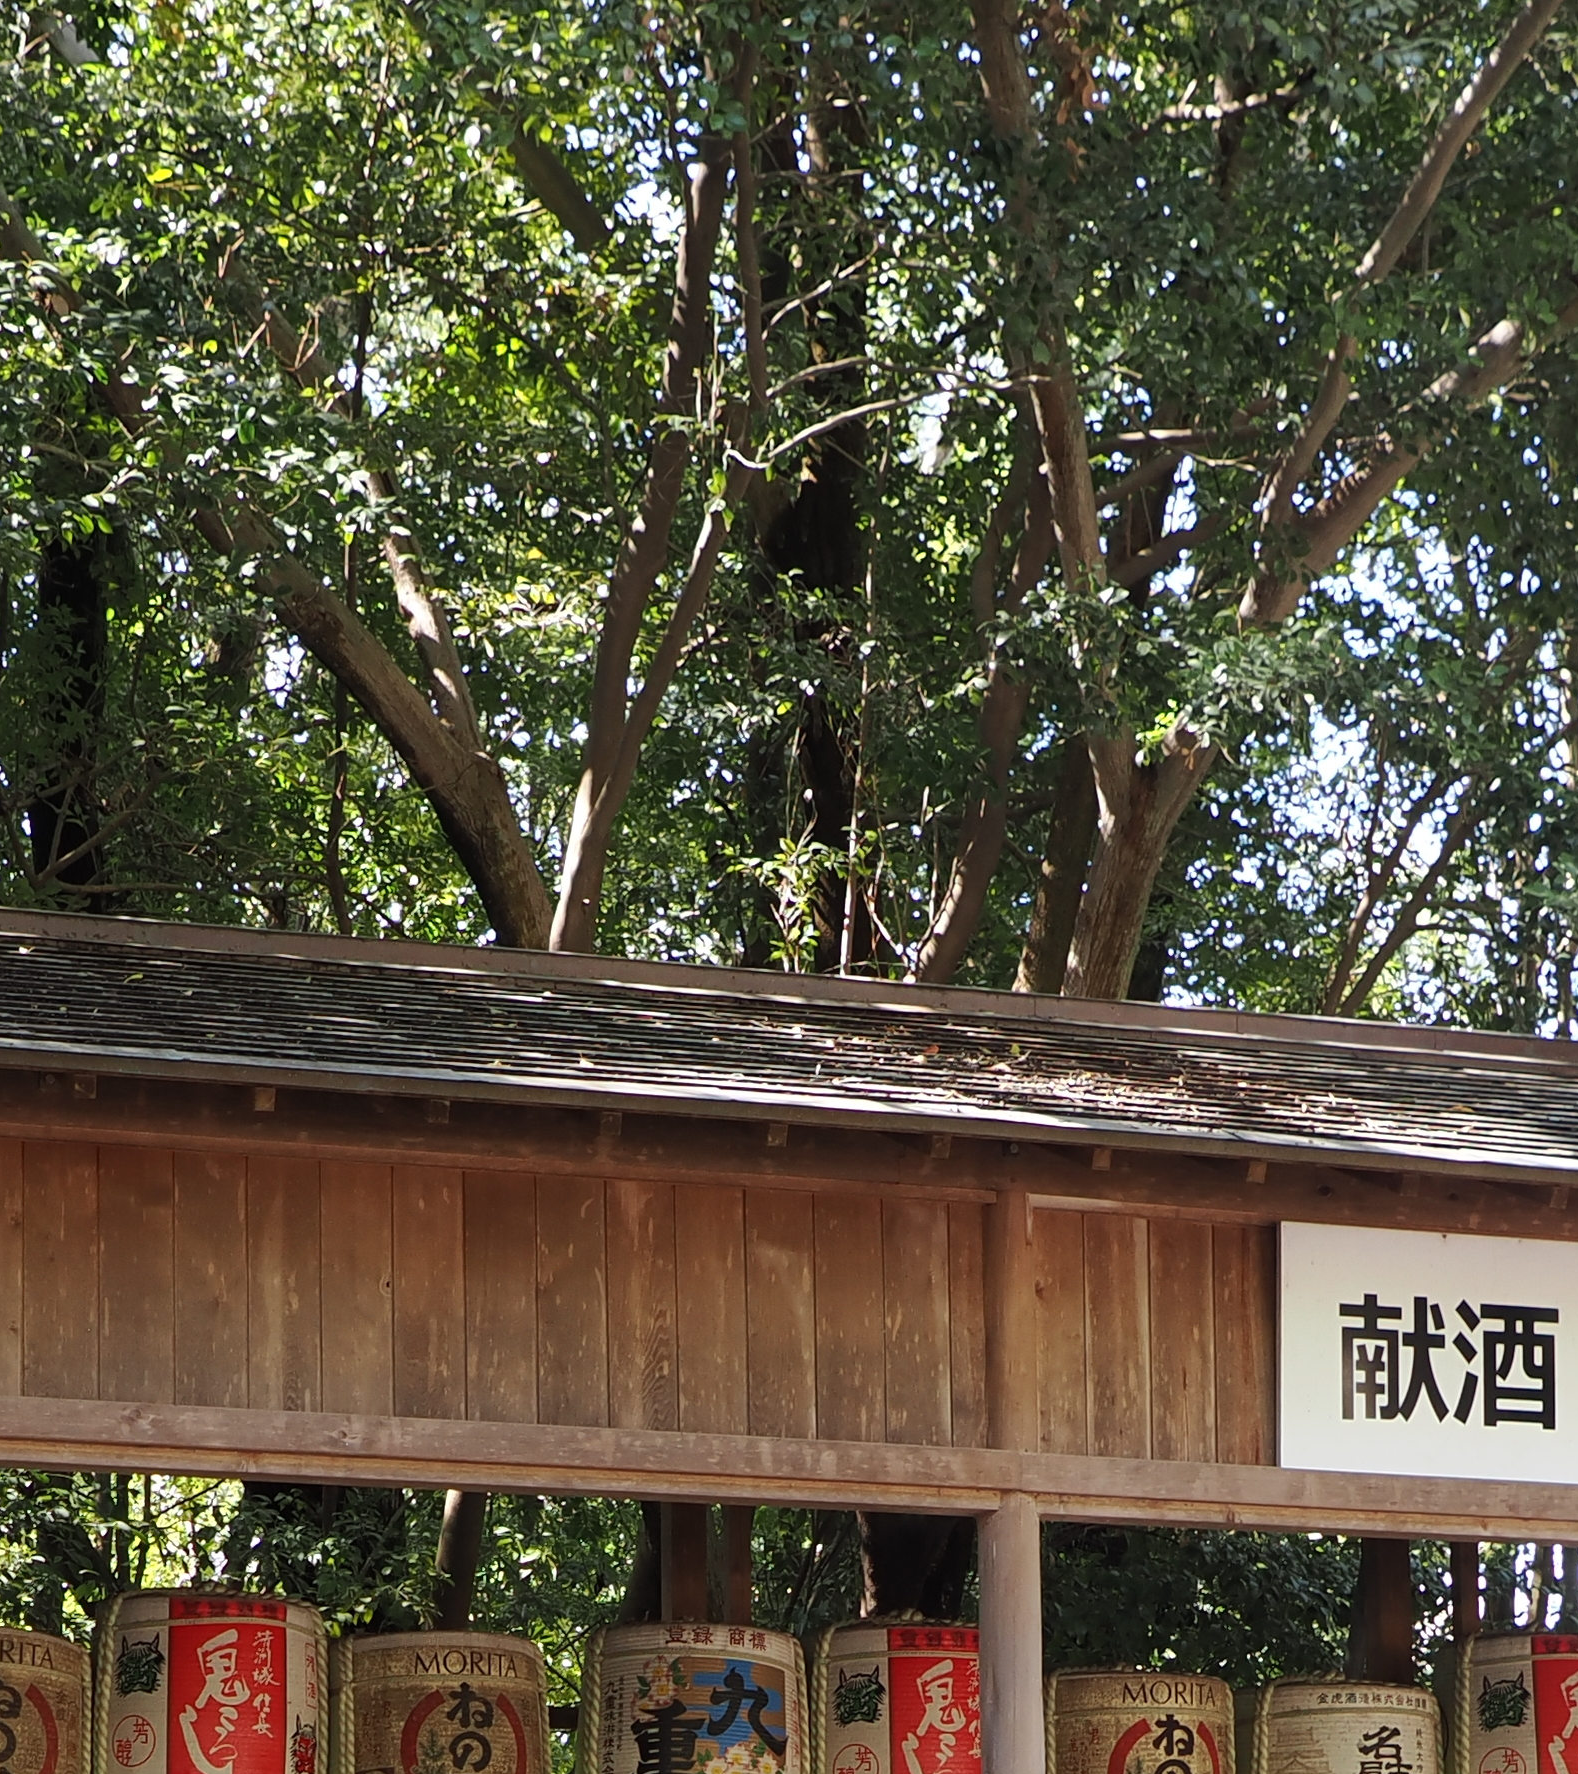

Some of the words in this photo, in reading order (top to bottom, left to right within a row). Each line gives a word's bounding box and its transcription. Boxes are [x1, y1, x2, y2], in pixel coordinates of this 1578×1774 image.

[1339, 1293, 1559, 1431] 献酒
[665, 1626, 713, 1644] 登録
[729, 1630, 767, 1650] 商標
[413, 1649, 518, 1678] MORITA
[1122, 1681, 1216, 1707] MORITA
[116, 1718, 150, 1763] 芳醇
